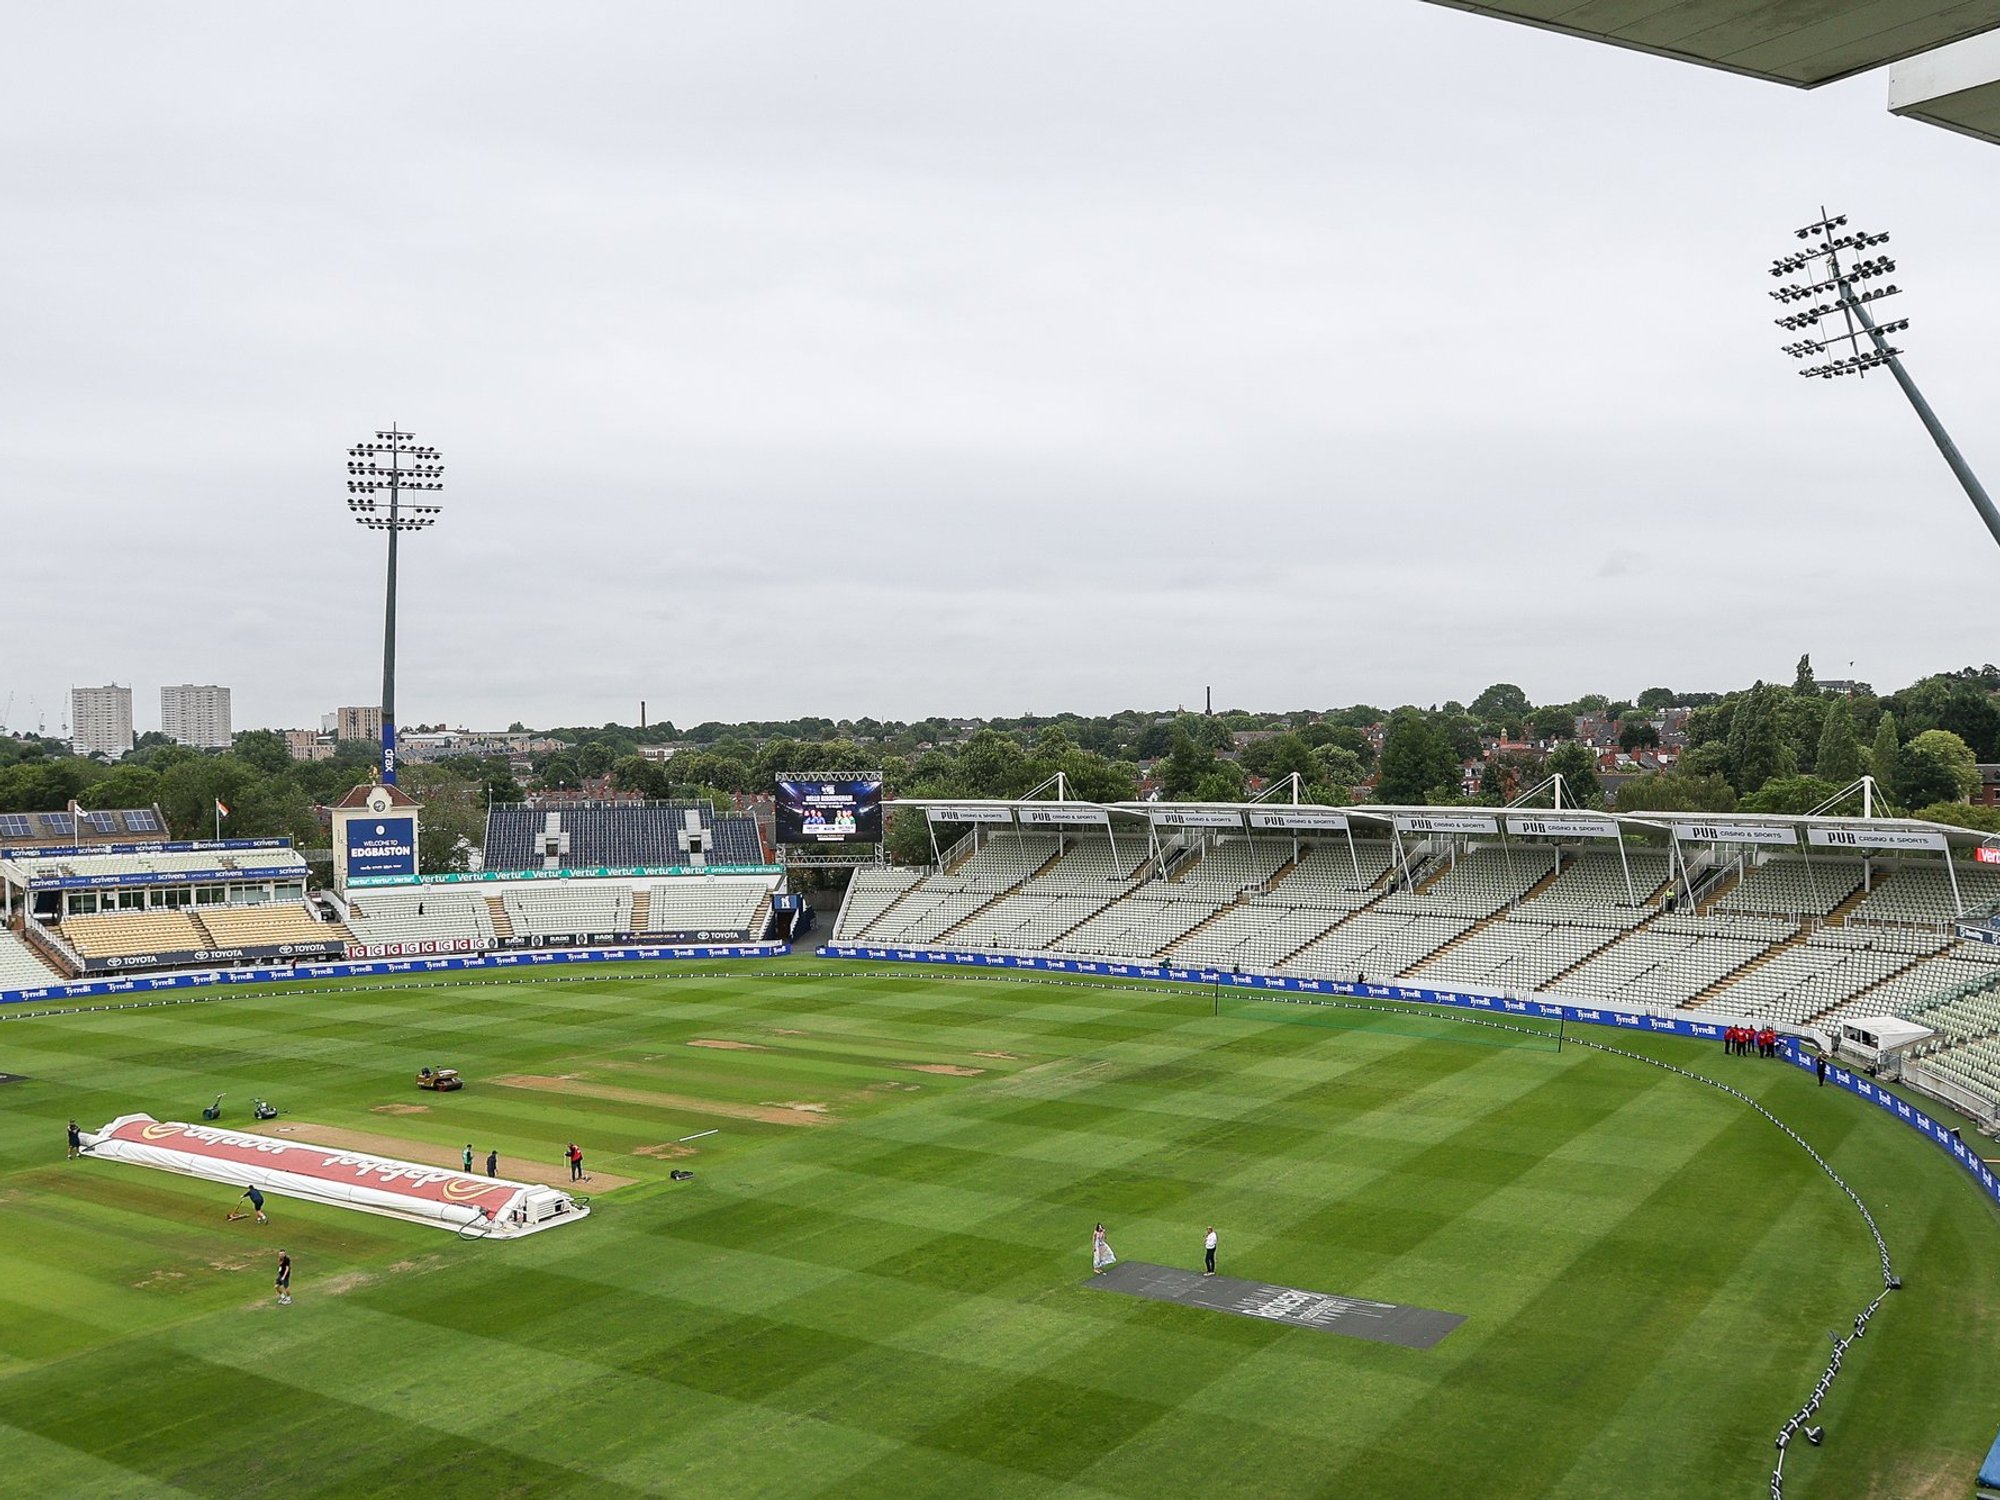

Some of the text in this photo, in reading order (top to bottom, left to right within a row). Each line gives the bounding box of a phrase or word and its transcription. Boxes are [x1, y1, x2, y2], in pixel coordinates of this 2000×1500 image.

[384, 749, 394, 772] drax
[940, 812, 958, 820] PUB
[1032, 813, 1051, 821] PUB
[1165, 814, 1184, 823] PUB
[1264, 817, 1284, 826] PUB
[1410, 820, 1432, 829] PUB
[1523, 822, 1546, 833] PUB
[1692, 827, 1718, 839] PUB
[1828, 832, 1856, 844] PUB
[351, 846, 410, 857] EDGBASTON
[532, 870, 558, 878] Vertu
[569, 869, 595, 877] Vertu
[607, 868, 632, 876] Vertu
[644, 867, 668, 875] Vertu
[680, 866, 704, 874] Vertu
[31, 879, 60, 887] scrivens
[90, 876, 120, 884] scrivens
[214, 870, 243, 878] scrivens
[278, 867, 306, 875] scrivens
[457, 874, 484, 882] Vertu
[495, 871, 521, 879] Vertu
[419, 876, 445, 884] Vertu
[294, 944, 326, 952] TOYOTA
[352, 939, 485, 956] IG IG IG IG IG IG IG IG
[210, 949, 243, 959] TOYOTA
[123, 955, 158, 964] TOYOTA
[1576, 1009, 1600, 1020] Tyrrells
[1614, 1014, 1639, 1025] Tyrrells
[1650, 1018, 1675, 1029] Tyrrells
[1690, 1024, 1716, 1035] Tyrrells
